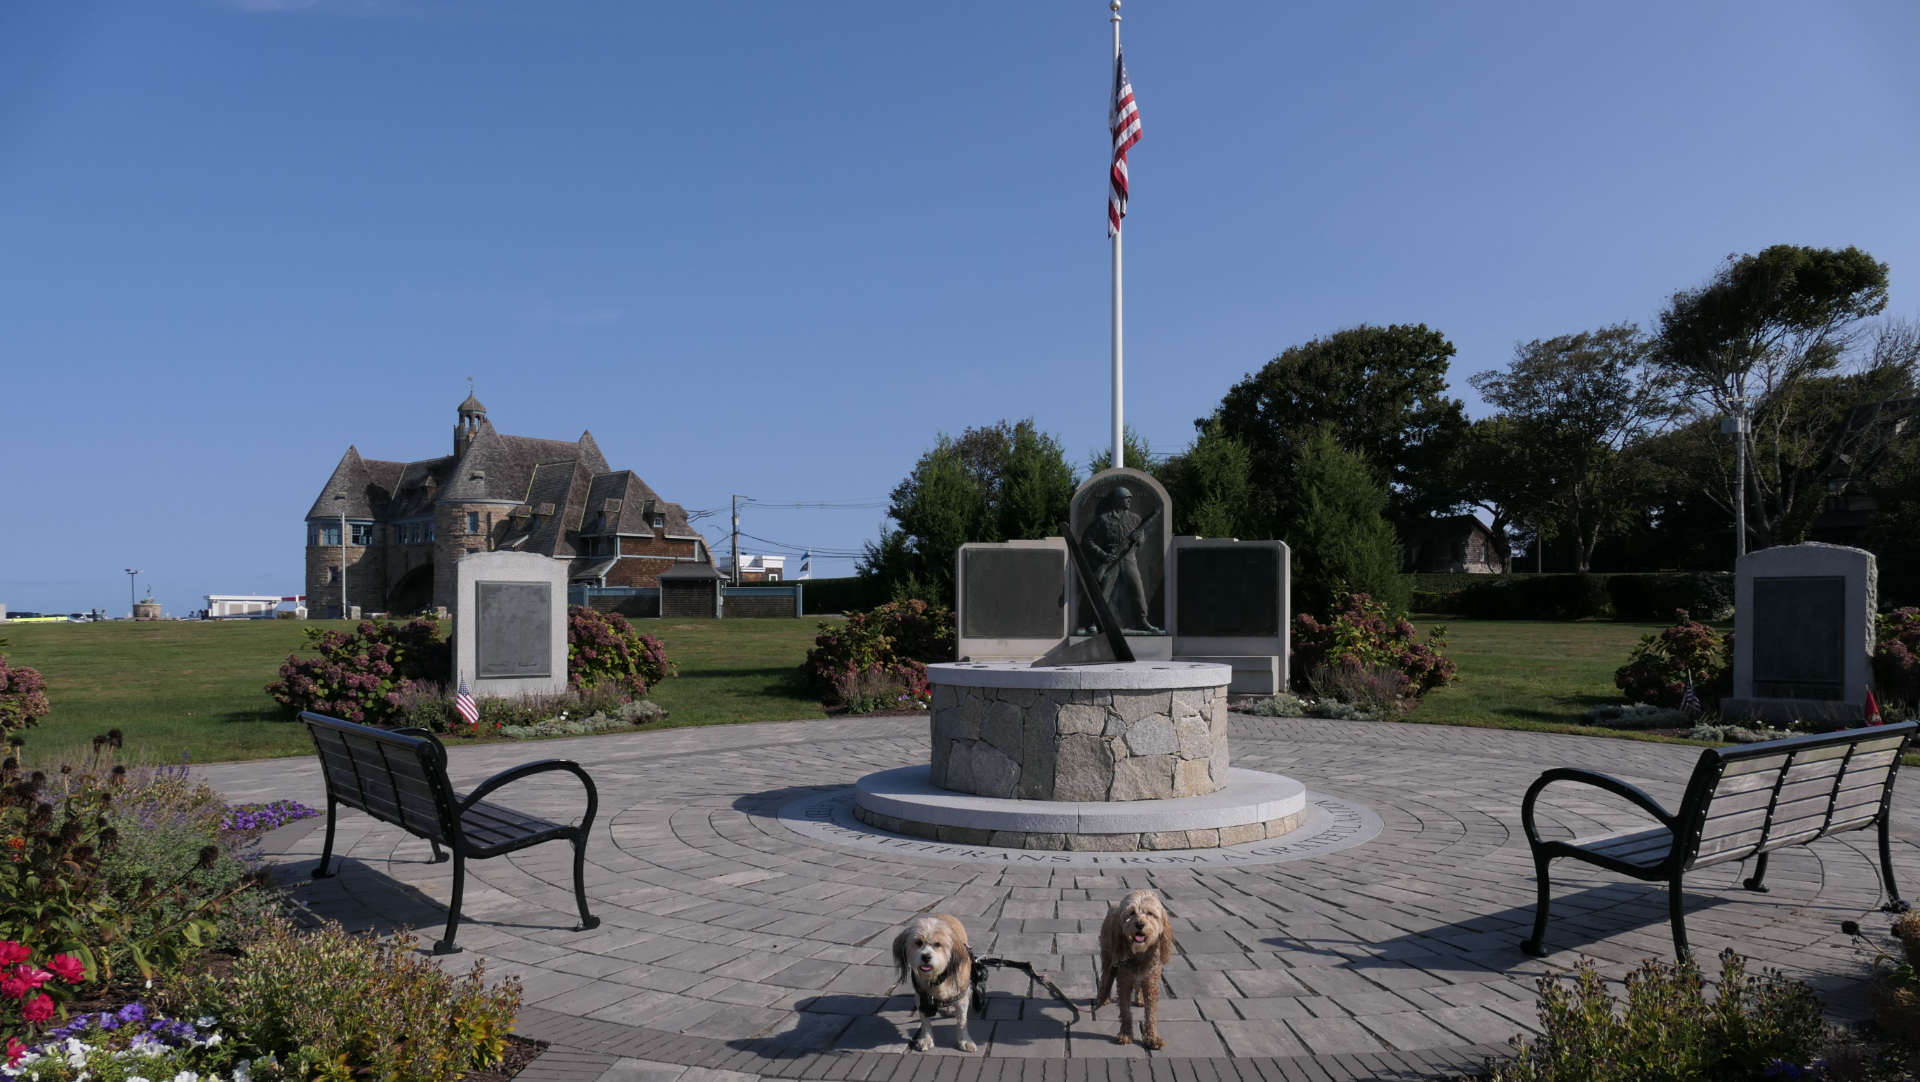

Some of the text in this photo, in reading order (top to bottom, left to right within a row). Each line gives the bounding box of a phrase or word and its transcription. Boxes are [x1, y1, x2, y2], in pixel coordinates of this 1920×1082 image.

[878, 837, 1071, 863] VETERANS
[1093, 854, 1209, 864] FROM
[1250, 823, 1362, 857] GRATEFUL
